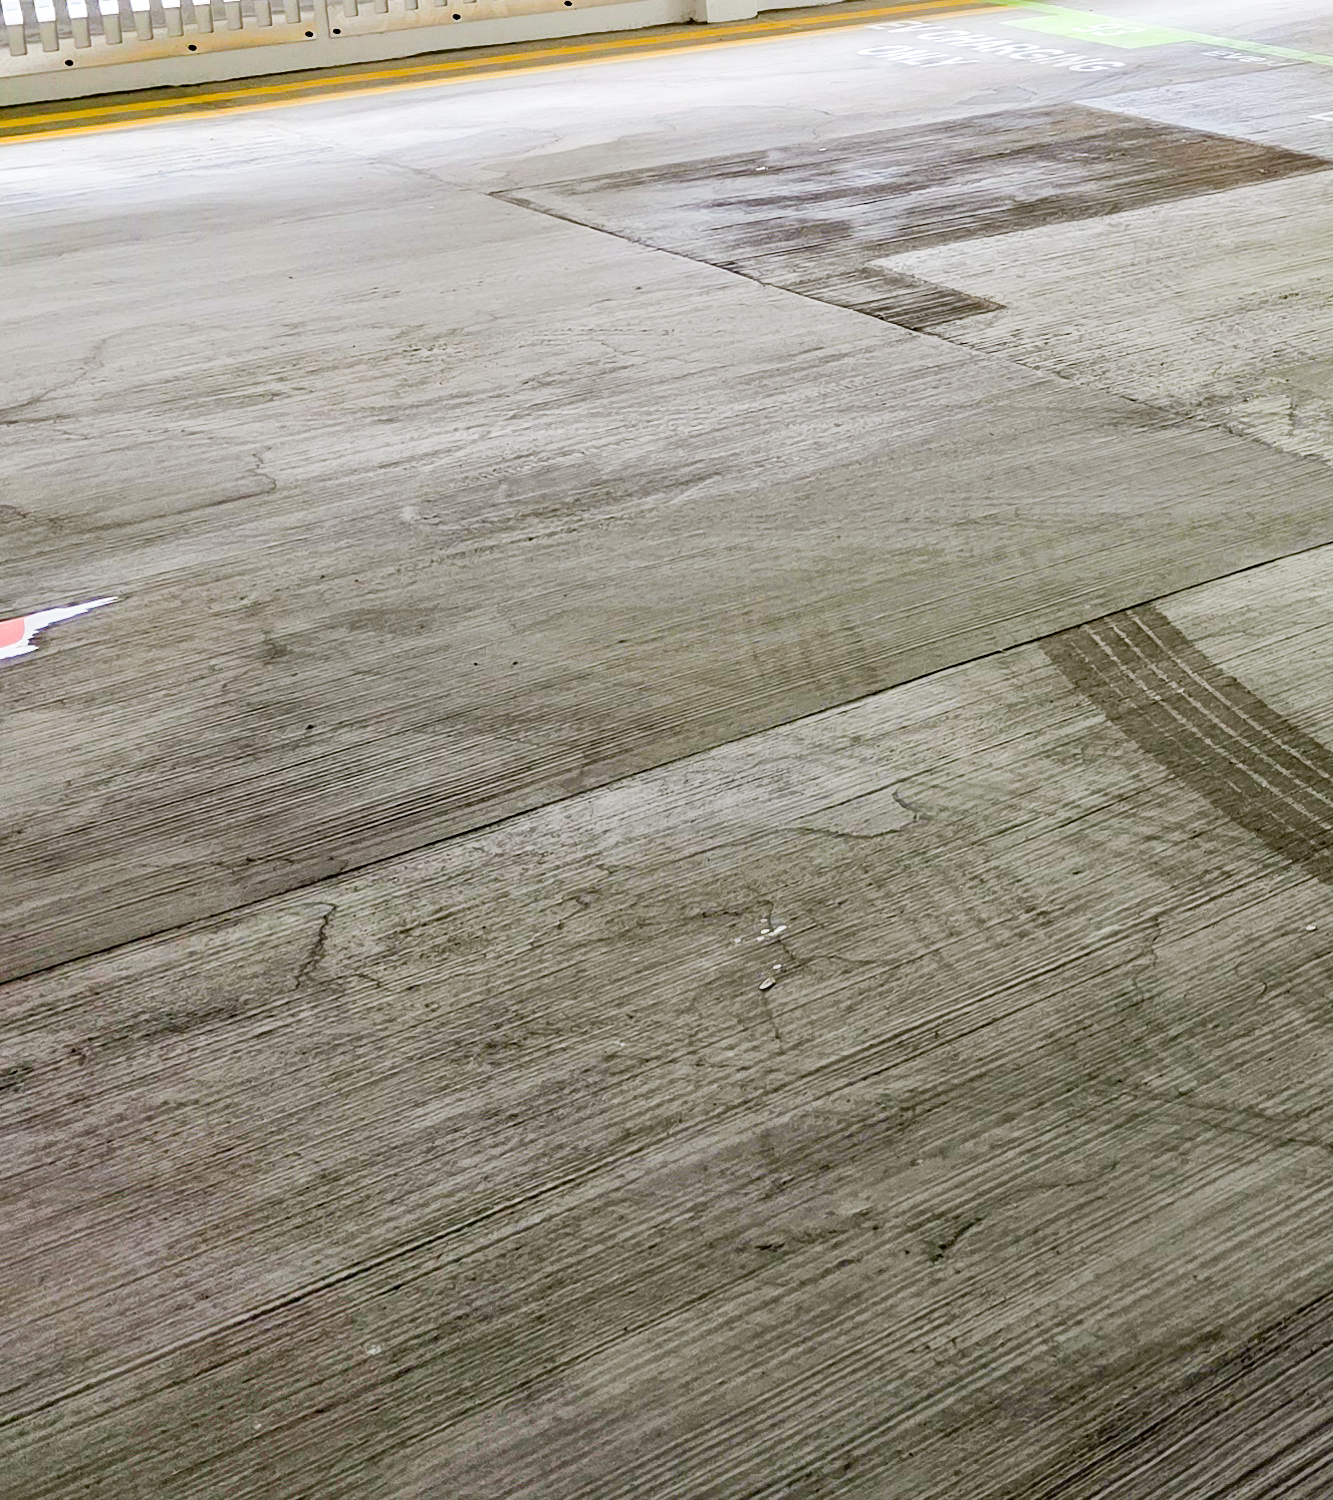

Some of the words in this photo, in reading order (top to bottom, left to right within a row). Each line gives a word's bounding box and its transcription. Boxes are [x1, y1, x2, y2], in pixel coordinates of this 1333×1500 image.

[858, 44, 980, 68] ONLY
[864, 19, 946, 33] EV
[916, 29, 1126, 72] CHARGING
